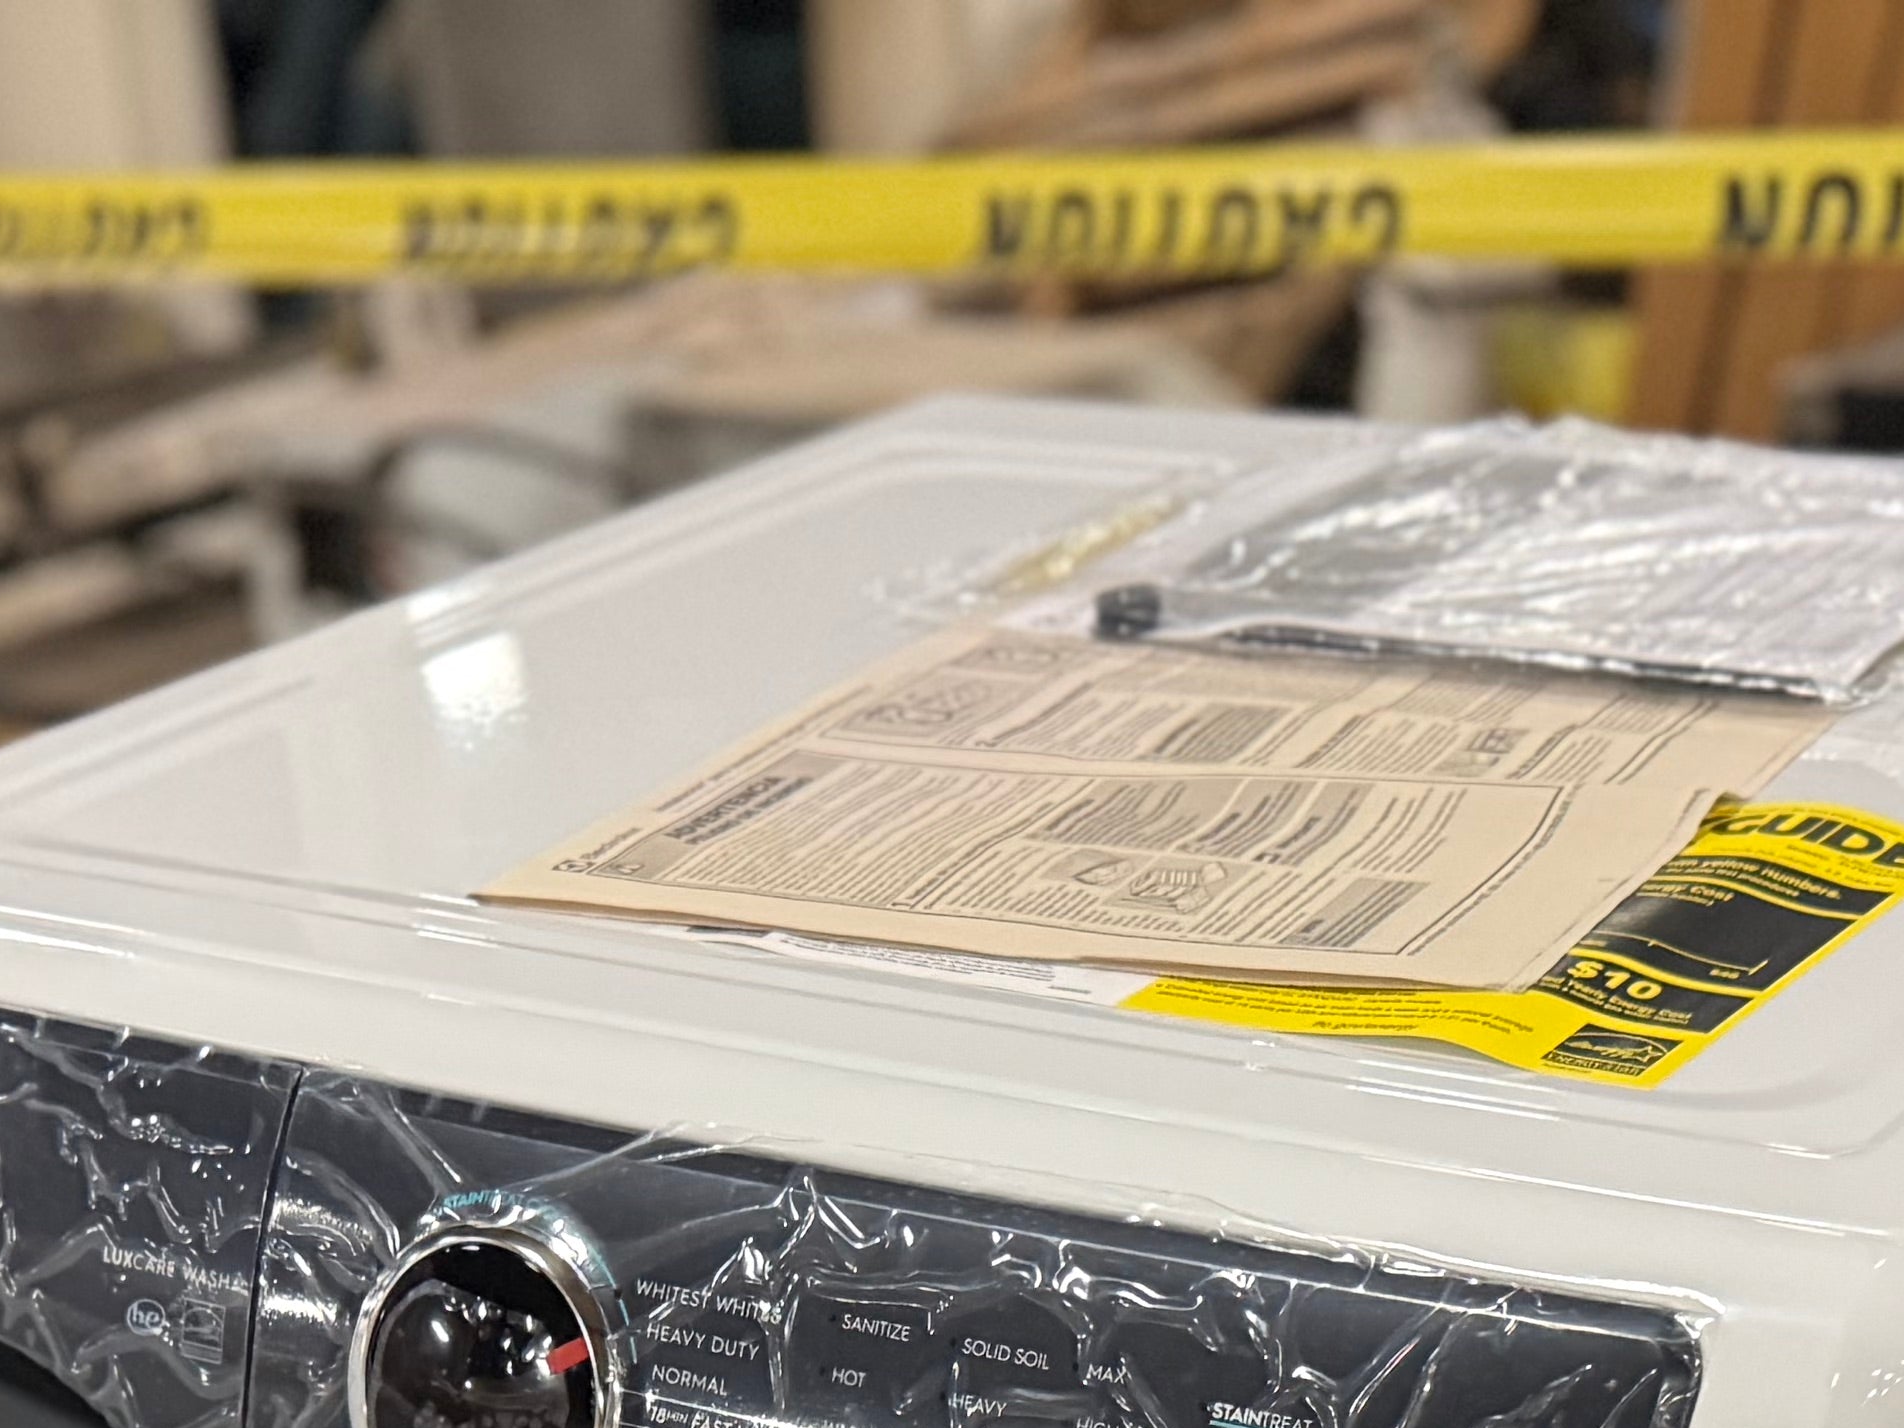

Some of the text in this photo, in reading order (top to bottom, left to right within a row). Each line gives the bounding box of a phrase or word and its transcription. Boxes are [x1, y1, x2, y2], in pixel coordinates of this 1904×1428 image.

[978, 186, 1406, 262] CAUTION
[1567, 960, 1663, 1000] $10
[103, 1245, 175, 1279] LUXCARE
[637, 1279, 711, 1309] WHITEST
[647, 1322, 760, 1361] HEAVY DUTY
[841, 1313, 911, 1342] SANITIZE
[962, 1337, 1050, 1370] SOLID SOIL
[652, 1364, 728, 1397] NORMAL
[832, 1367, 867, 1388] HOT
[1087, 1362, 1126, 1385] MAX
